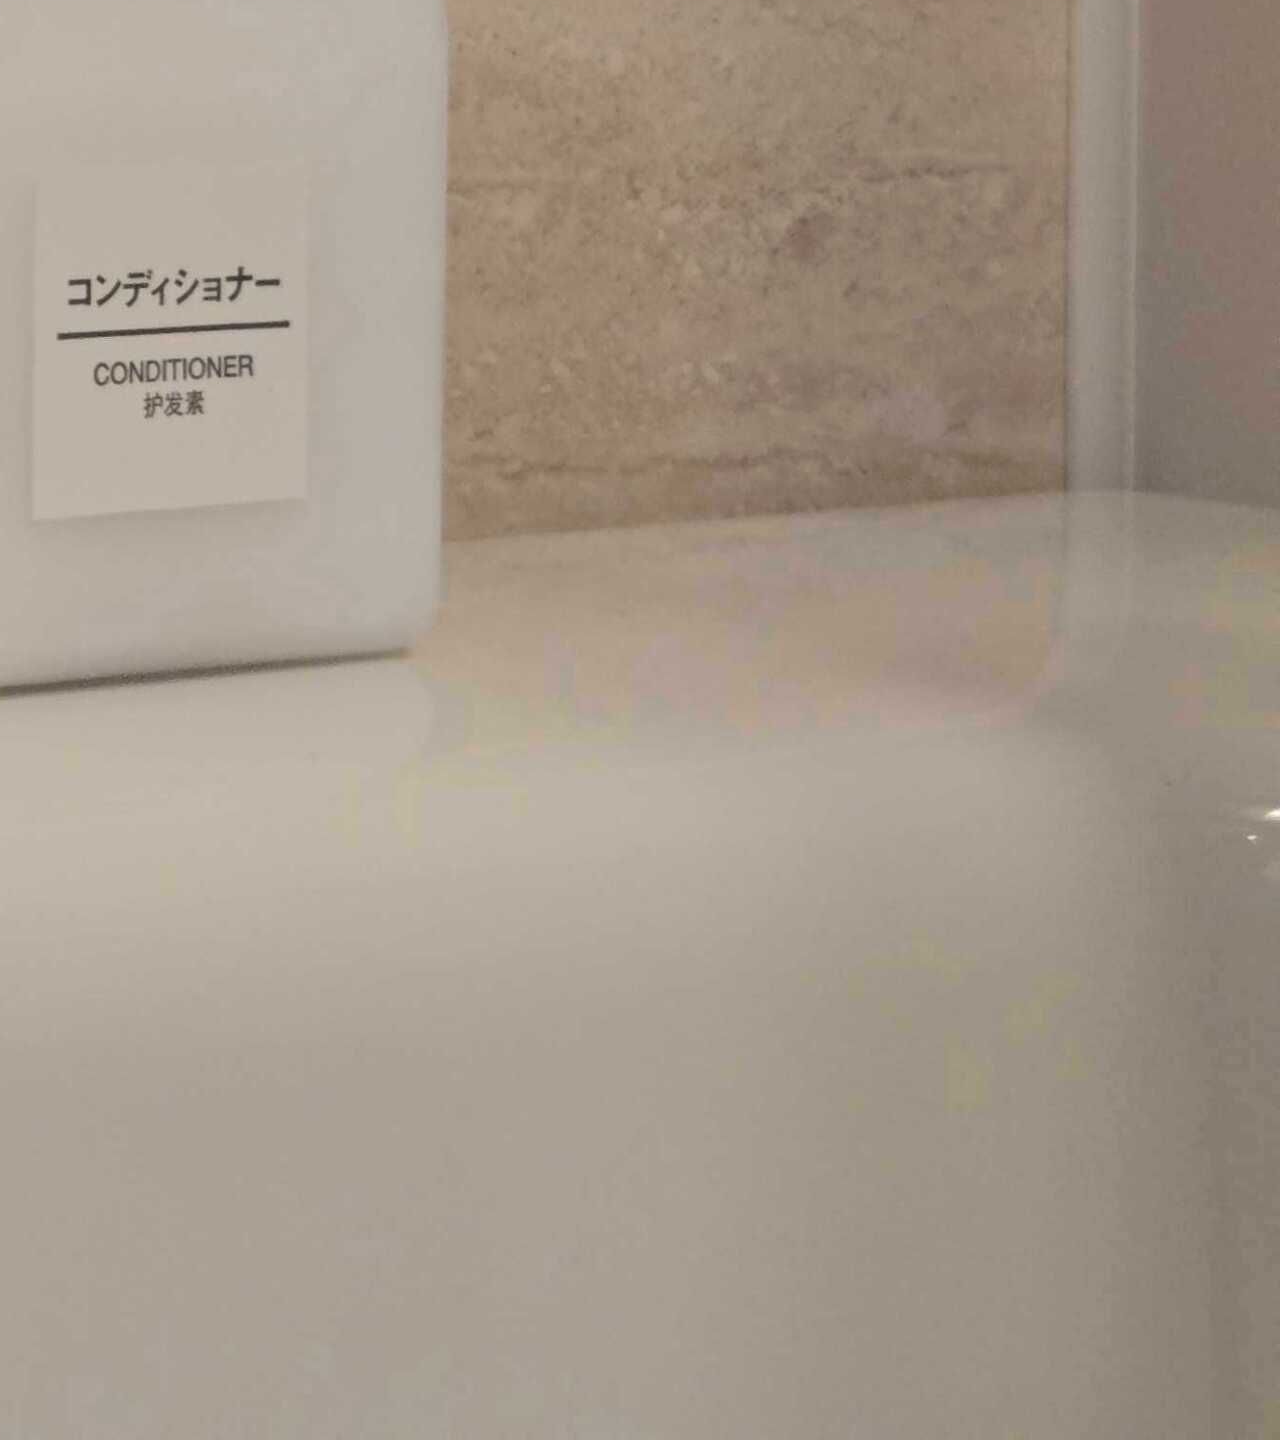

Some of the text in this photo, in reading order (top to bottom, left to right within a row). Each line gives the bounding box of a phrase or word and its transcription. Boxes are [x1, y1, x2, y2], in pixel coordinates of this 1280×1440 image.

[67, 265, 282, 309] コンディショナー
[92, 354, 255, 388] CONDITIONER
[142, 389, 206, 420] 护发素
